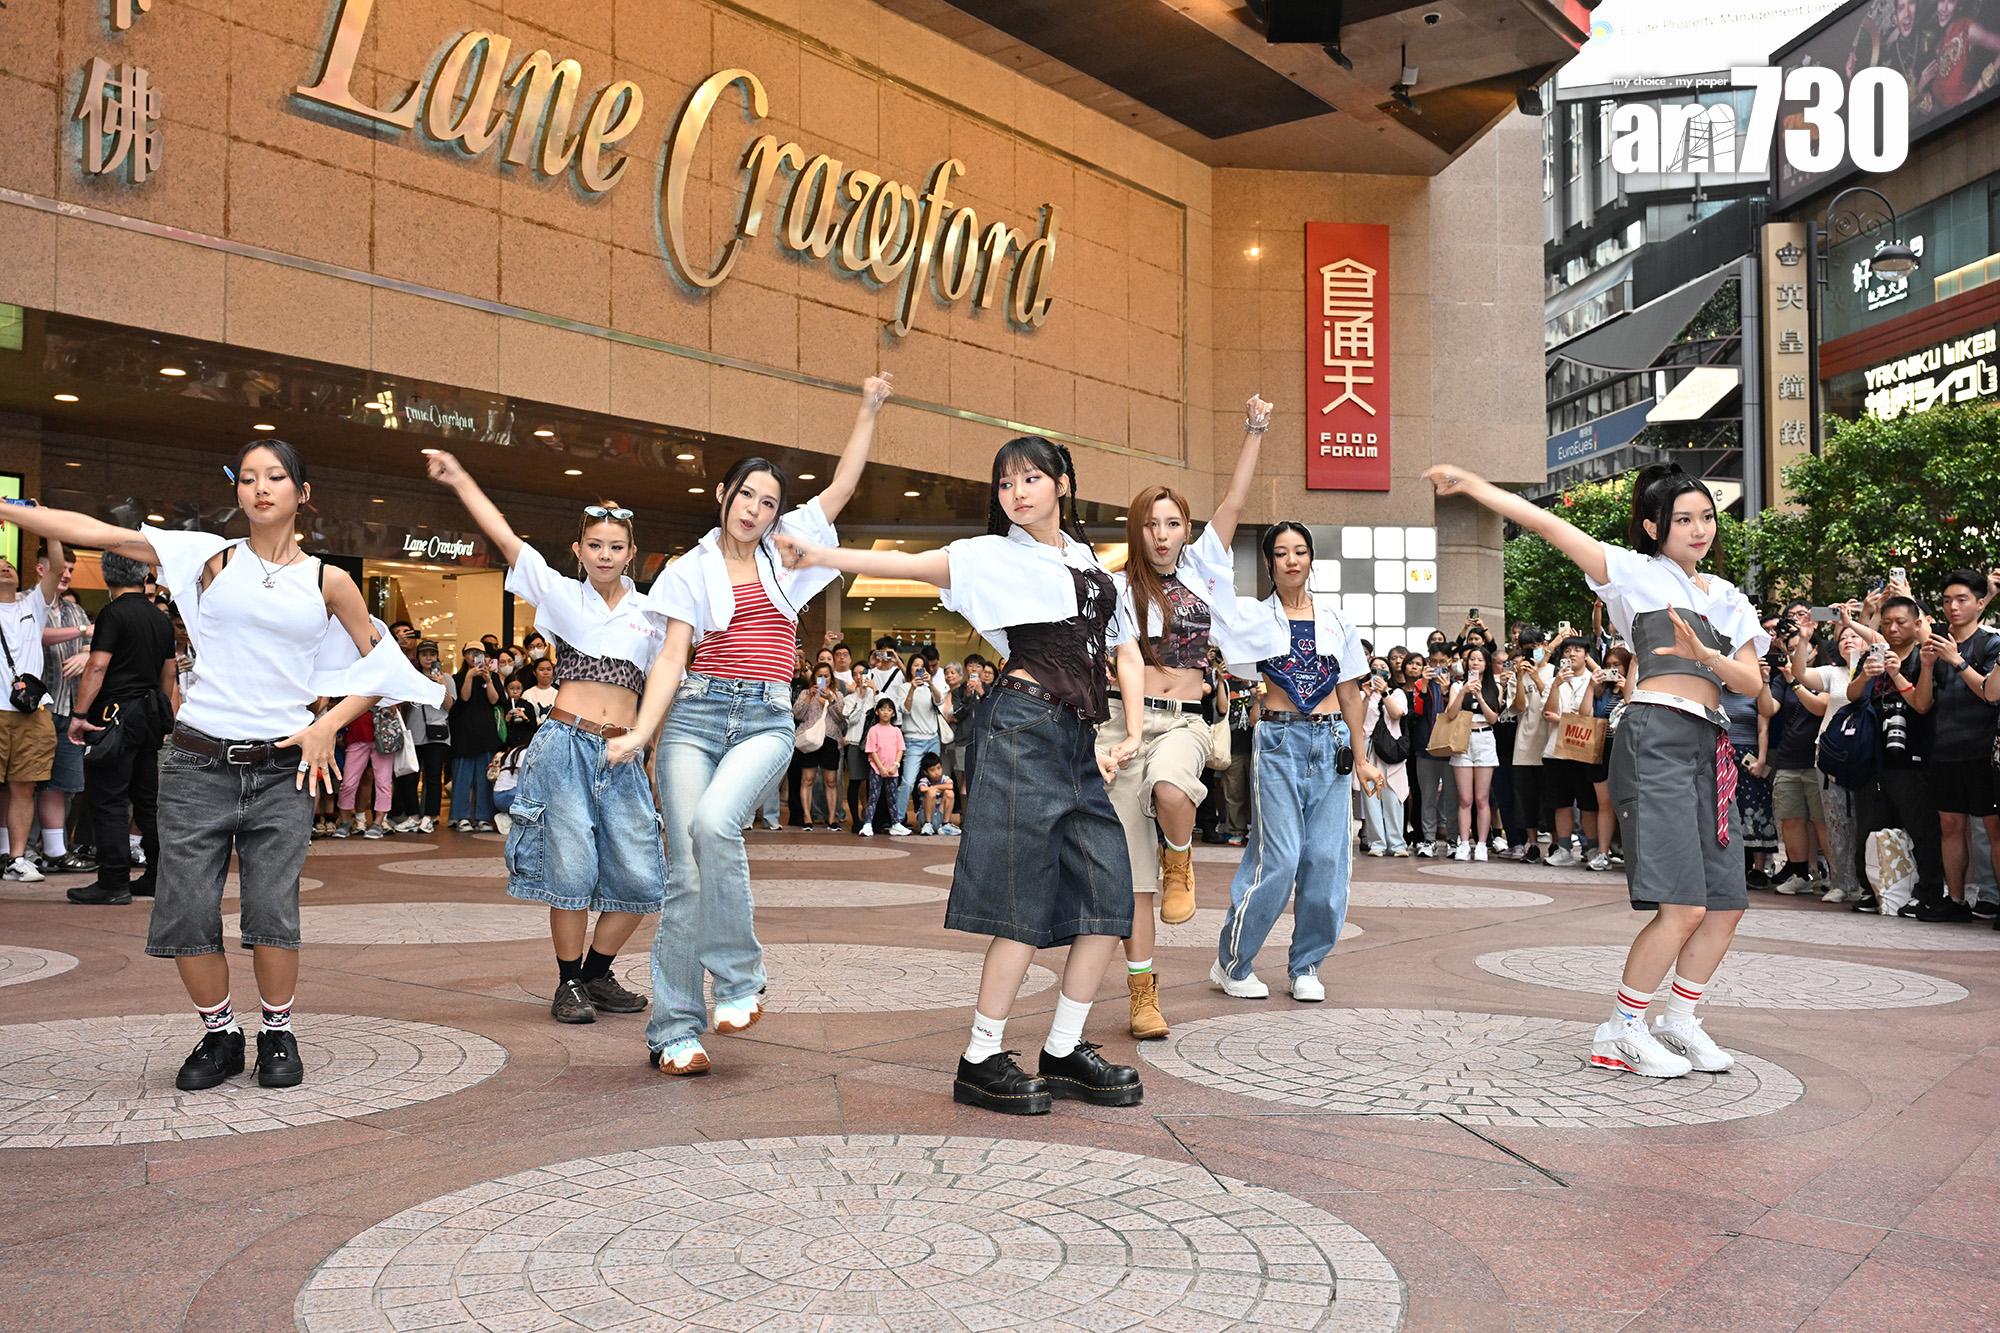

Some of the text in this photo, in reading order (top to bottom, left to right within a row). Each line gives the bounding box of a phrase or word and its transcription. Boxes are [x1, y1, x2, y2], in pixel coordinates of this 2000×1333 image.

[72, 0, 165, 184] 佛
[290, 0, 1062, 337] Lane Crawford
[1320, 432, 1377, 444] FOOD
[1558, 438, 1593, 461] EuroEyes
[1320, 445, 1378, 457] FORUM
[402, 534, 475, 560] Lane Crawford
[1565, 724, 1592, 741] MUJI
